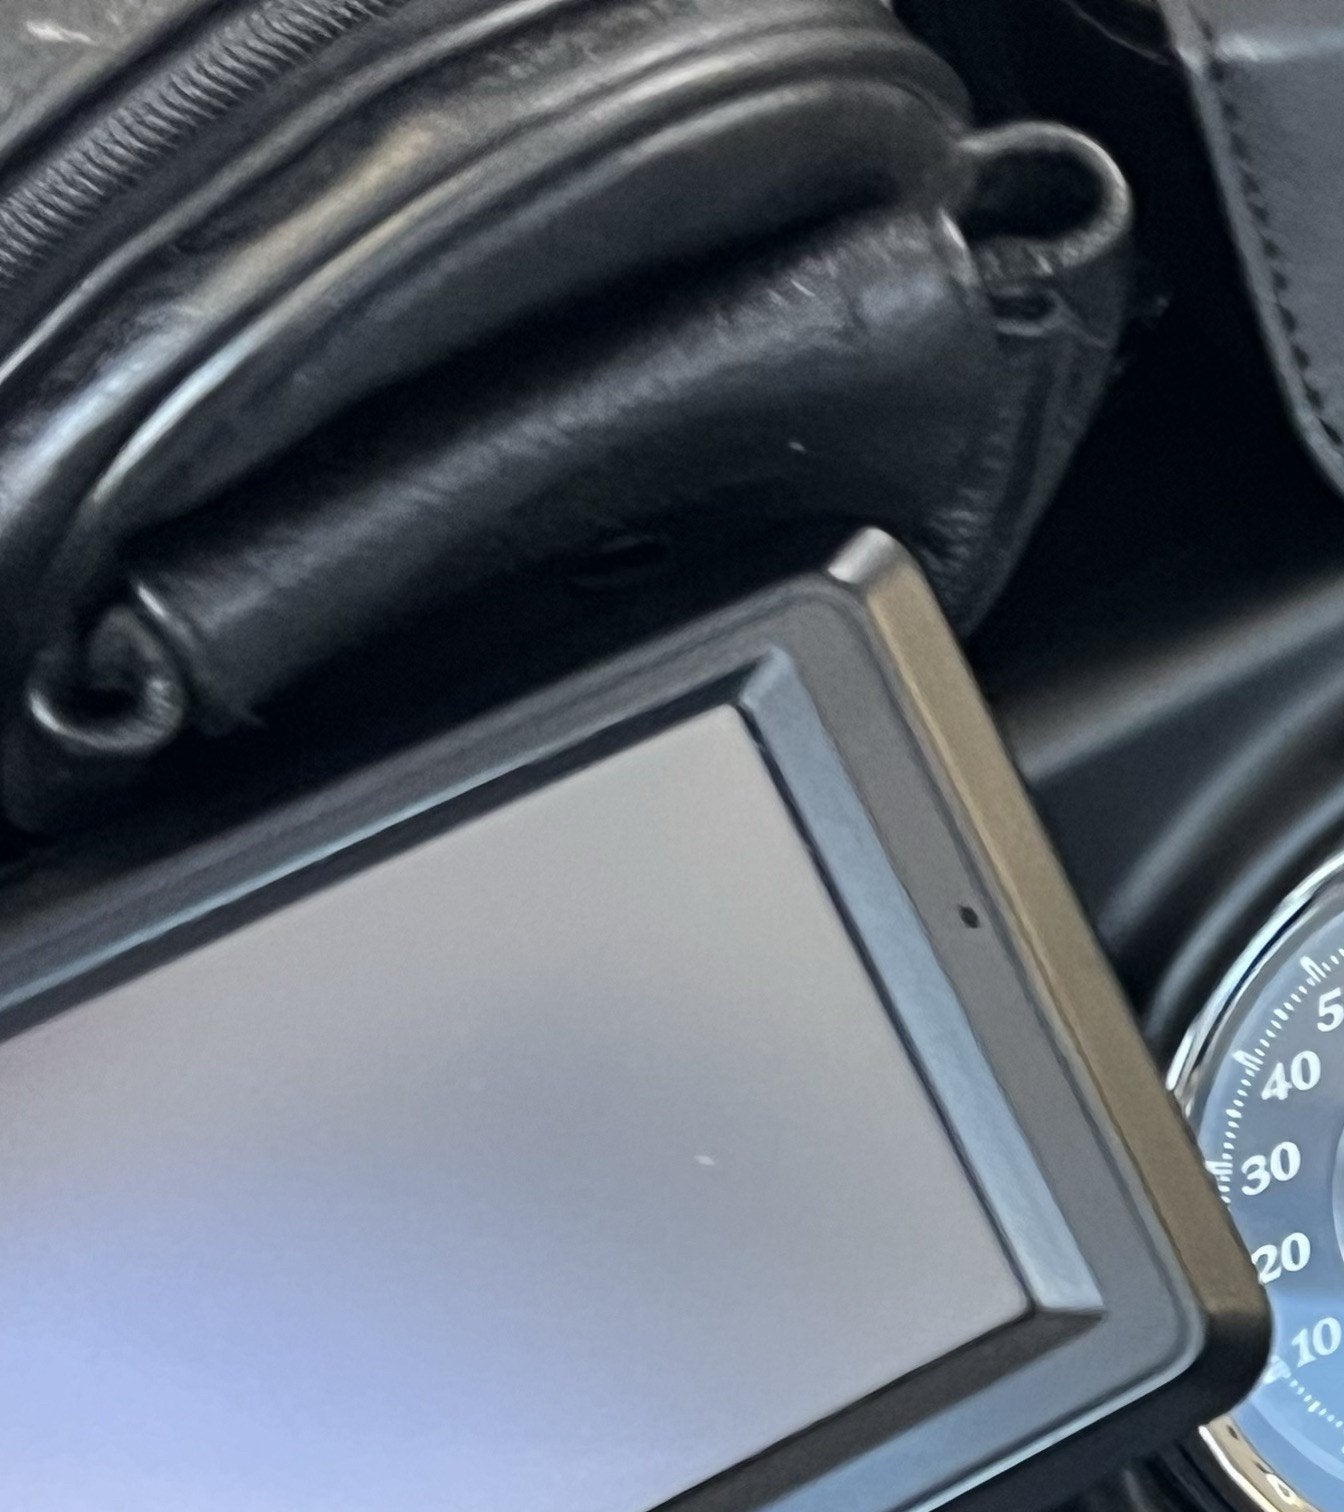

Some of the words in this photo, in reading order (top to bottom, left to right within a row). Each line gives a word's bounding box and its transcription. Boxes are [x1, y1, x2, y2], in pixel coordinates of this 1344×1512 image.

[1260, 1050, 1322, 1102] 40
[1240, 1141, 1301, 1197] 30
[1253, 1231, 1311, 1282] 20
[1290, 1316, 1342, 1367] 10
